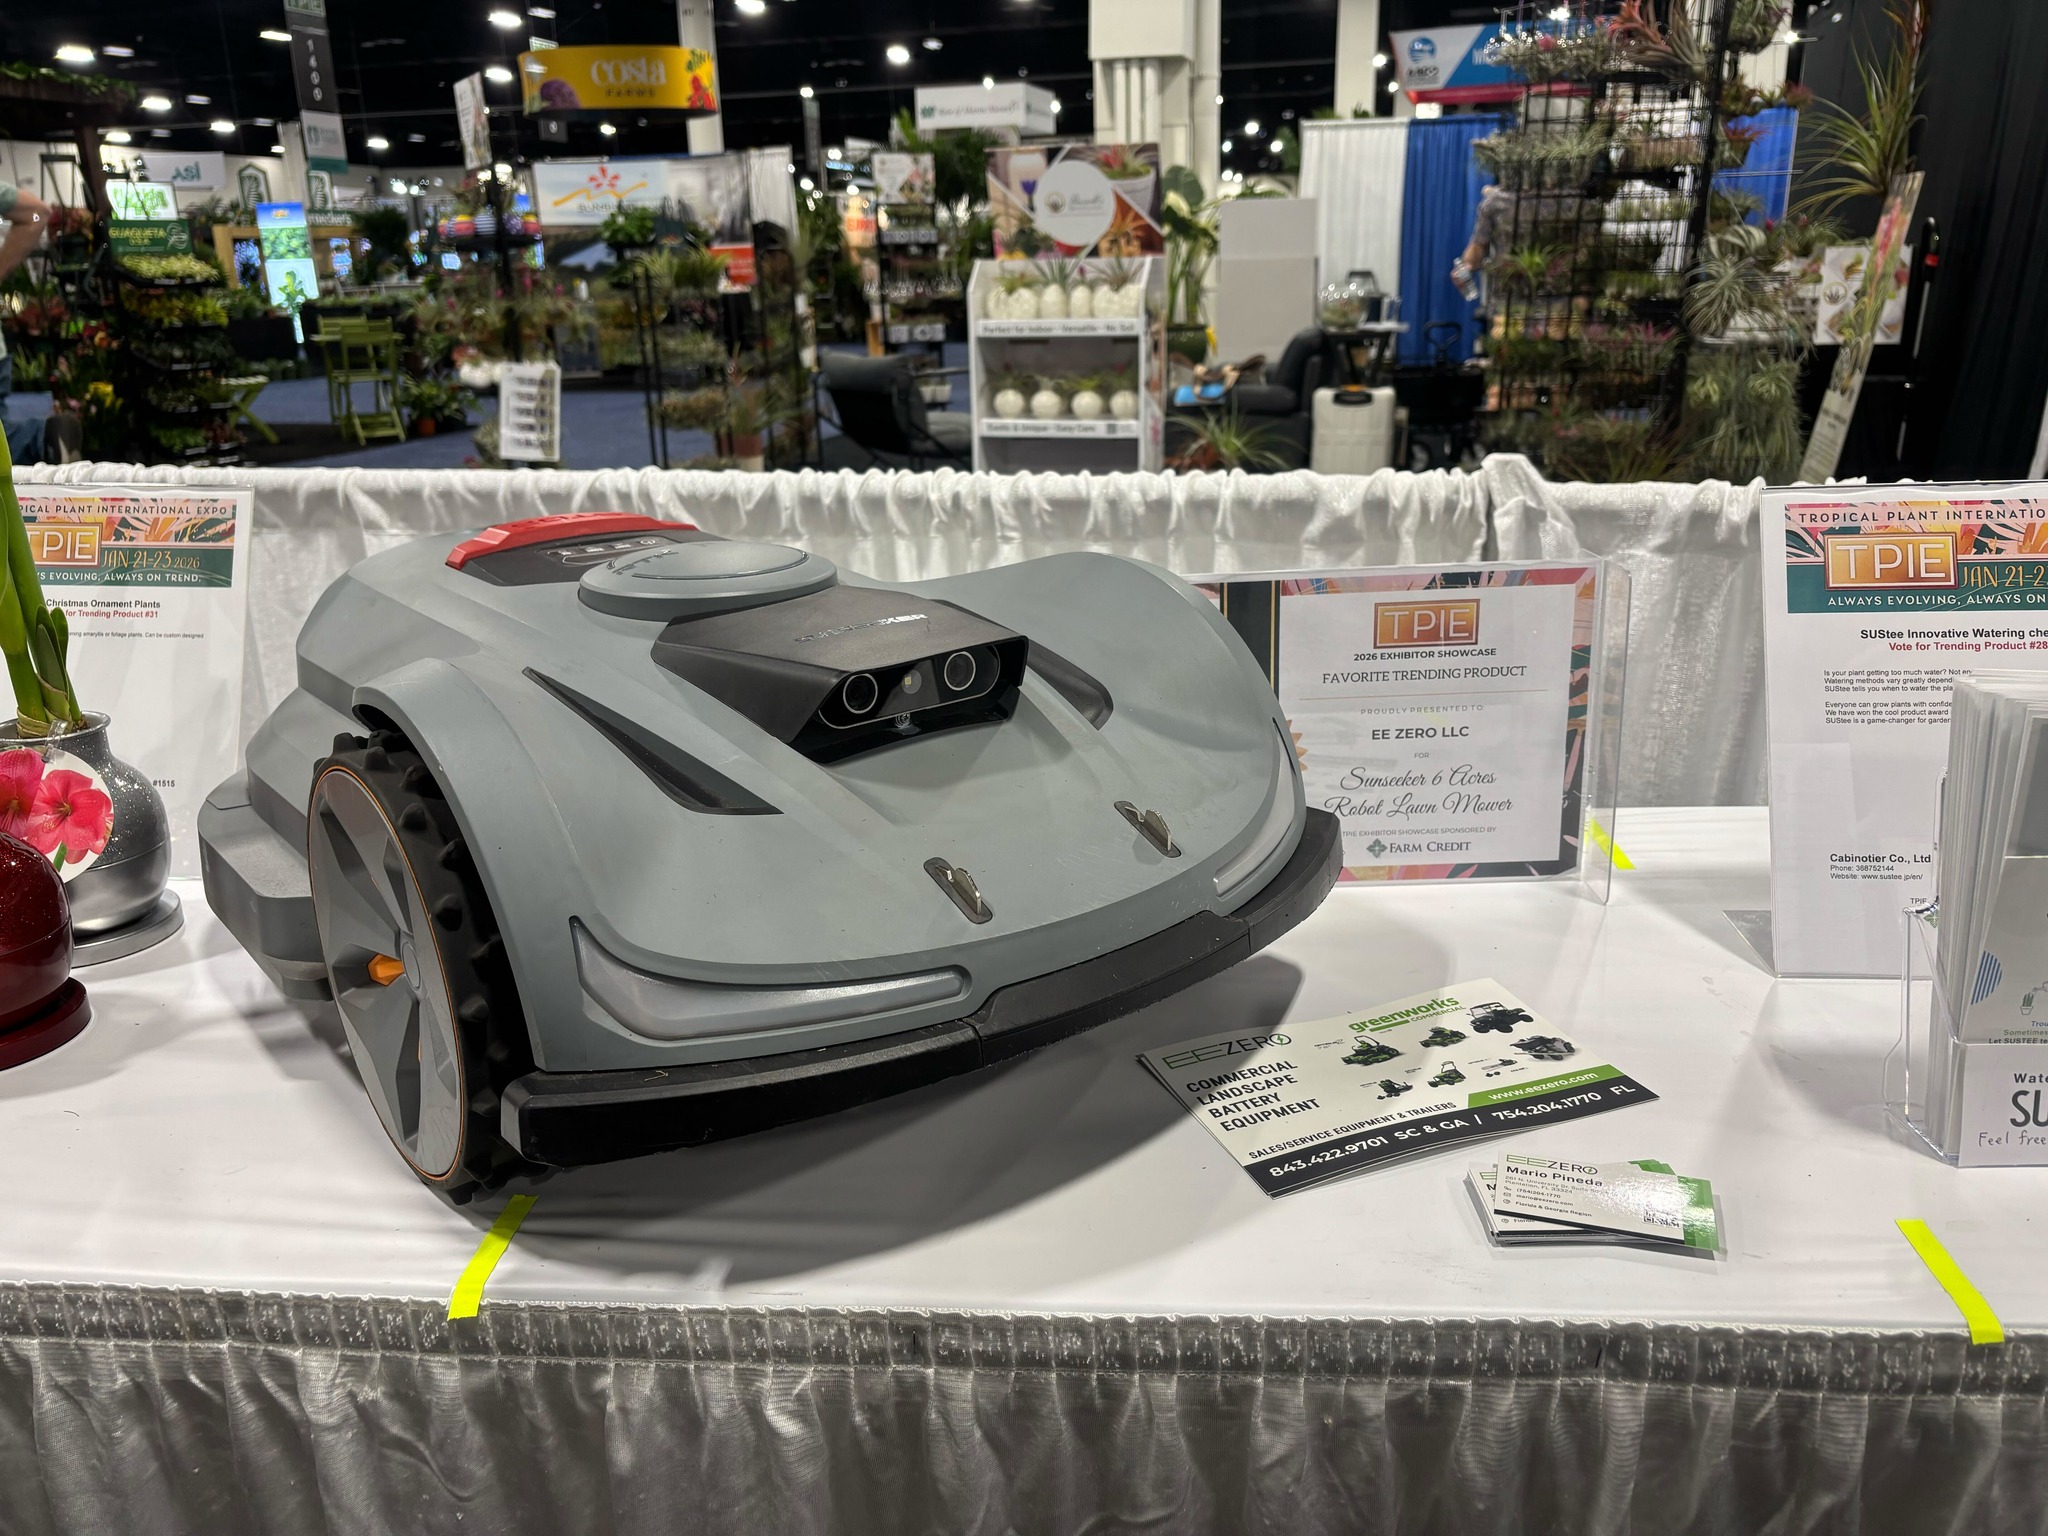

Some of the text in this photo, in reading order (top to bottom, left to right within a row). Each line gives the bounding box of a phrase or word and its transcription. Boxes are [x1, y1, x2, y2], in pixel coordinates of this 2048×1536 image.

[55, 505, 227, 515] PLANT INTERNATIONAL EXPO
[1799, 508, 2046, 523] TROPICAL PLANT INTERNATIO
[103, 550, 201, 569] JAN 21-23 2026
[1836, 543, 1946, 579] TPIE
[49, 572, 100, 582] EVOLVING,
[104, 572, 143, 582] ALWAYS
[147, 573, 161, 582] ON
[165, 573, 201, 583] TREND.
[1961, 565, 1998, 588] JAN
[46, 599, 161, 609] Christmas Ornament Plants
[1828, 594, 2046, 606] ALWAYS EVOLVING, ALWAYS ON
[78, 609, 111, 619] Trending
[113, 610, 143, 618] Product
[145, 610, 158, 618] #31
[1384, 608, 1470, 640] TPIE
[1860, 629, 1904, 639] SUStee
[1907, 628, 1969, 639] Innovative
[1972, 628, 2025, 640] Watering
[1353, 647, 1497, 661] 2026 EXHIBITOR SHOWCASE
[1888, 642, 1913, 651] Vote
[1915, 641, 1931, 651] for
[1933, 642, 1981, 652] Trending
[1984, 641, 2027, 650] Product
[1322, 665, 1528, 684] FAVORITE TRENDING PRODUCT
[1902, 677, 1925, 685] greatly
[1360, 707, 1408, 715] PROUDLY
[1410, 704, 1469, 714] PRESENTED
[1825, 701, 1857, 709] Everyone
[1866, 717, 1916, 725] game-changer
[1371, 726, 1470, 740] EE ZERO LLC
[1340, 763, 1498, 791] Sunseeker 6 Acres
[1324, 791, 1514, 821] Robot Lawn Mower
[1358, 829, 1397, 837] EXHIBITOR
[1398, 827, 1439, 836] SHOWCASE
[1440, 826, 1485, 835] SPONSORED
[1487, 825, 1497, 833] BY
[1389, 841, 1472, 853] FARM CREDIT
[1830, 853, 1931, 865] Cabinotier Co., Ltd
[1348, 997, 1460, 1033] greenworks
[1410, 1006, 1467, 1022] COMMERCIAL
[1162, 1033, 1292, 1070] EEZERO
[1186, 1060, 1298, 1093] COMMERCIAL
[1197, 1074, 1298, 1106] LANDSCAPE
[1488, 1071, 1599, 1100] www.eezero.com
[1208, 1092, 1282, 1119] BATTERY
[2010, 1089, 2048, 1128] SU
[1219, 1098, 1321, 1132] EQUIPMENT
[1248, 1101, 1457, 1160] SALES/SERVICE EQUIPMENT & TRAILERS
[1269, 1084, 1637, 1178] 843.422.9701 SC & GA 754.204.1770 FL
[1979, 1129, 2047, 1147] Feel free
[1506, 1154, 1598, 1175] EEZERO
[1506, 1165, 1548, 1179] Mario
[1552, 1172, 1603, 1187] Pineda
[1526, 1178, 1560, 1188] University
[1515, 1201, 1537, 1209] Florida
[1544, 1206, 1569, 1214] Georgia
